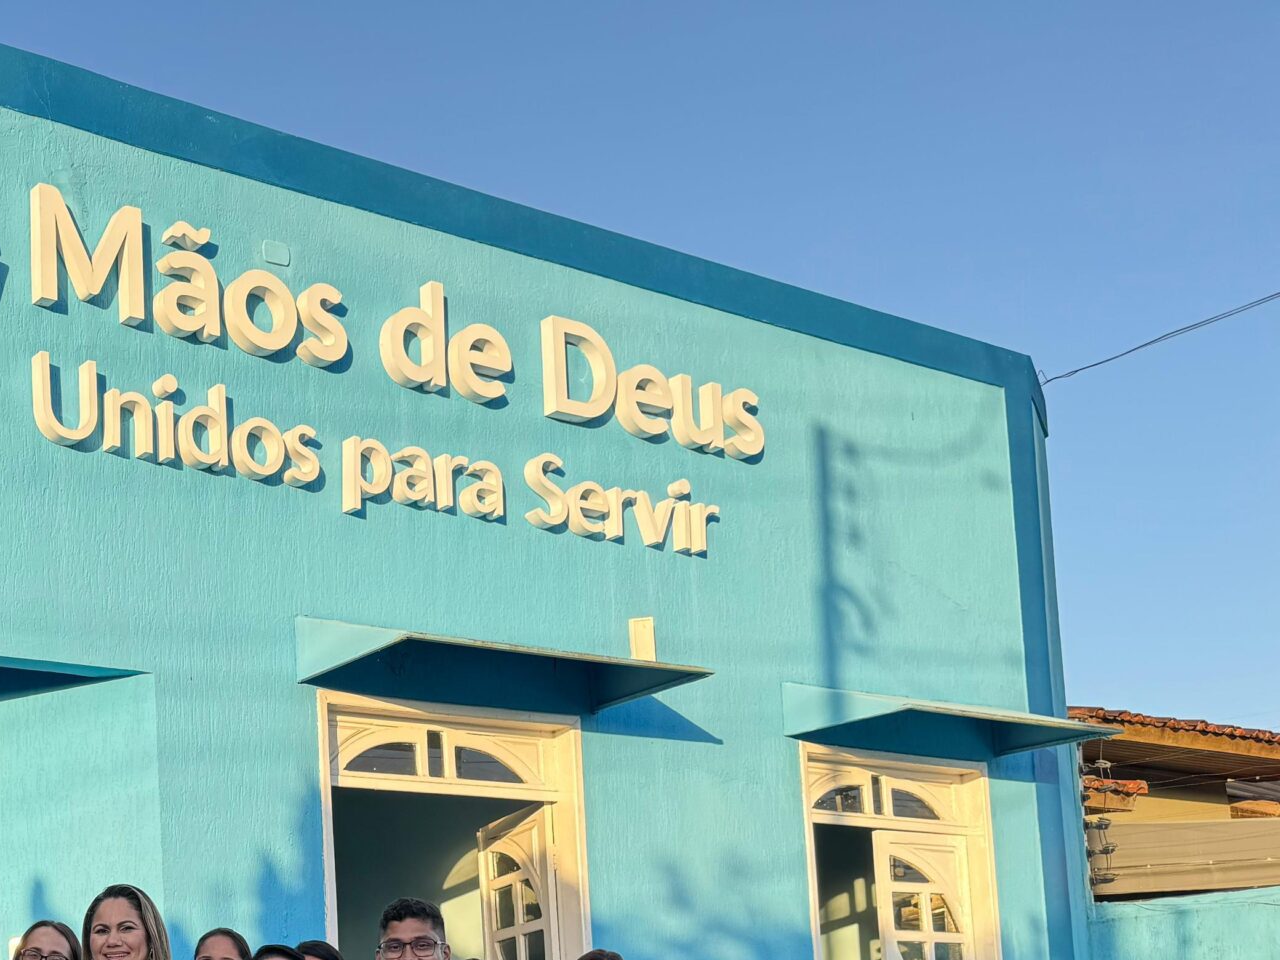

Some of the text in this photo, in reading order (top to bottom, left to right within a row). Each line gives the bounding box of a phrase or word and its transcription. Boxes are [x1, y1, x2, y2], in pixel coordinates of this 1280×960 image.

[30, 182, 764, 460] Mãos de Deus
[31, 350, 719, 557] Unidos para Servir
